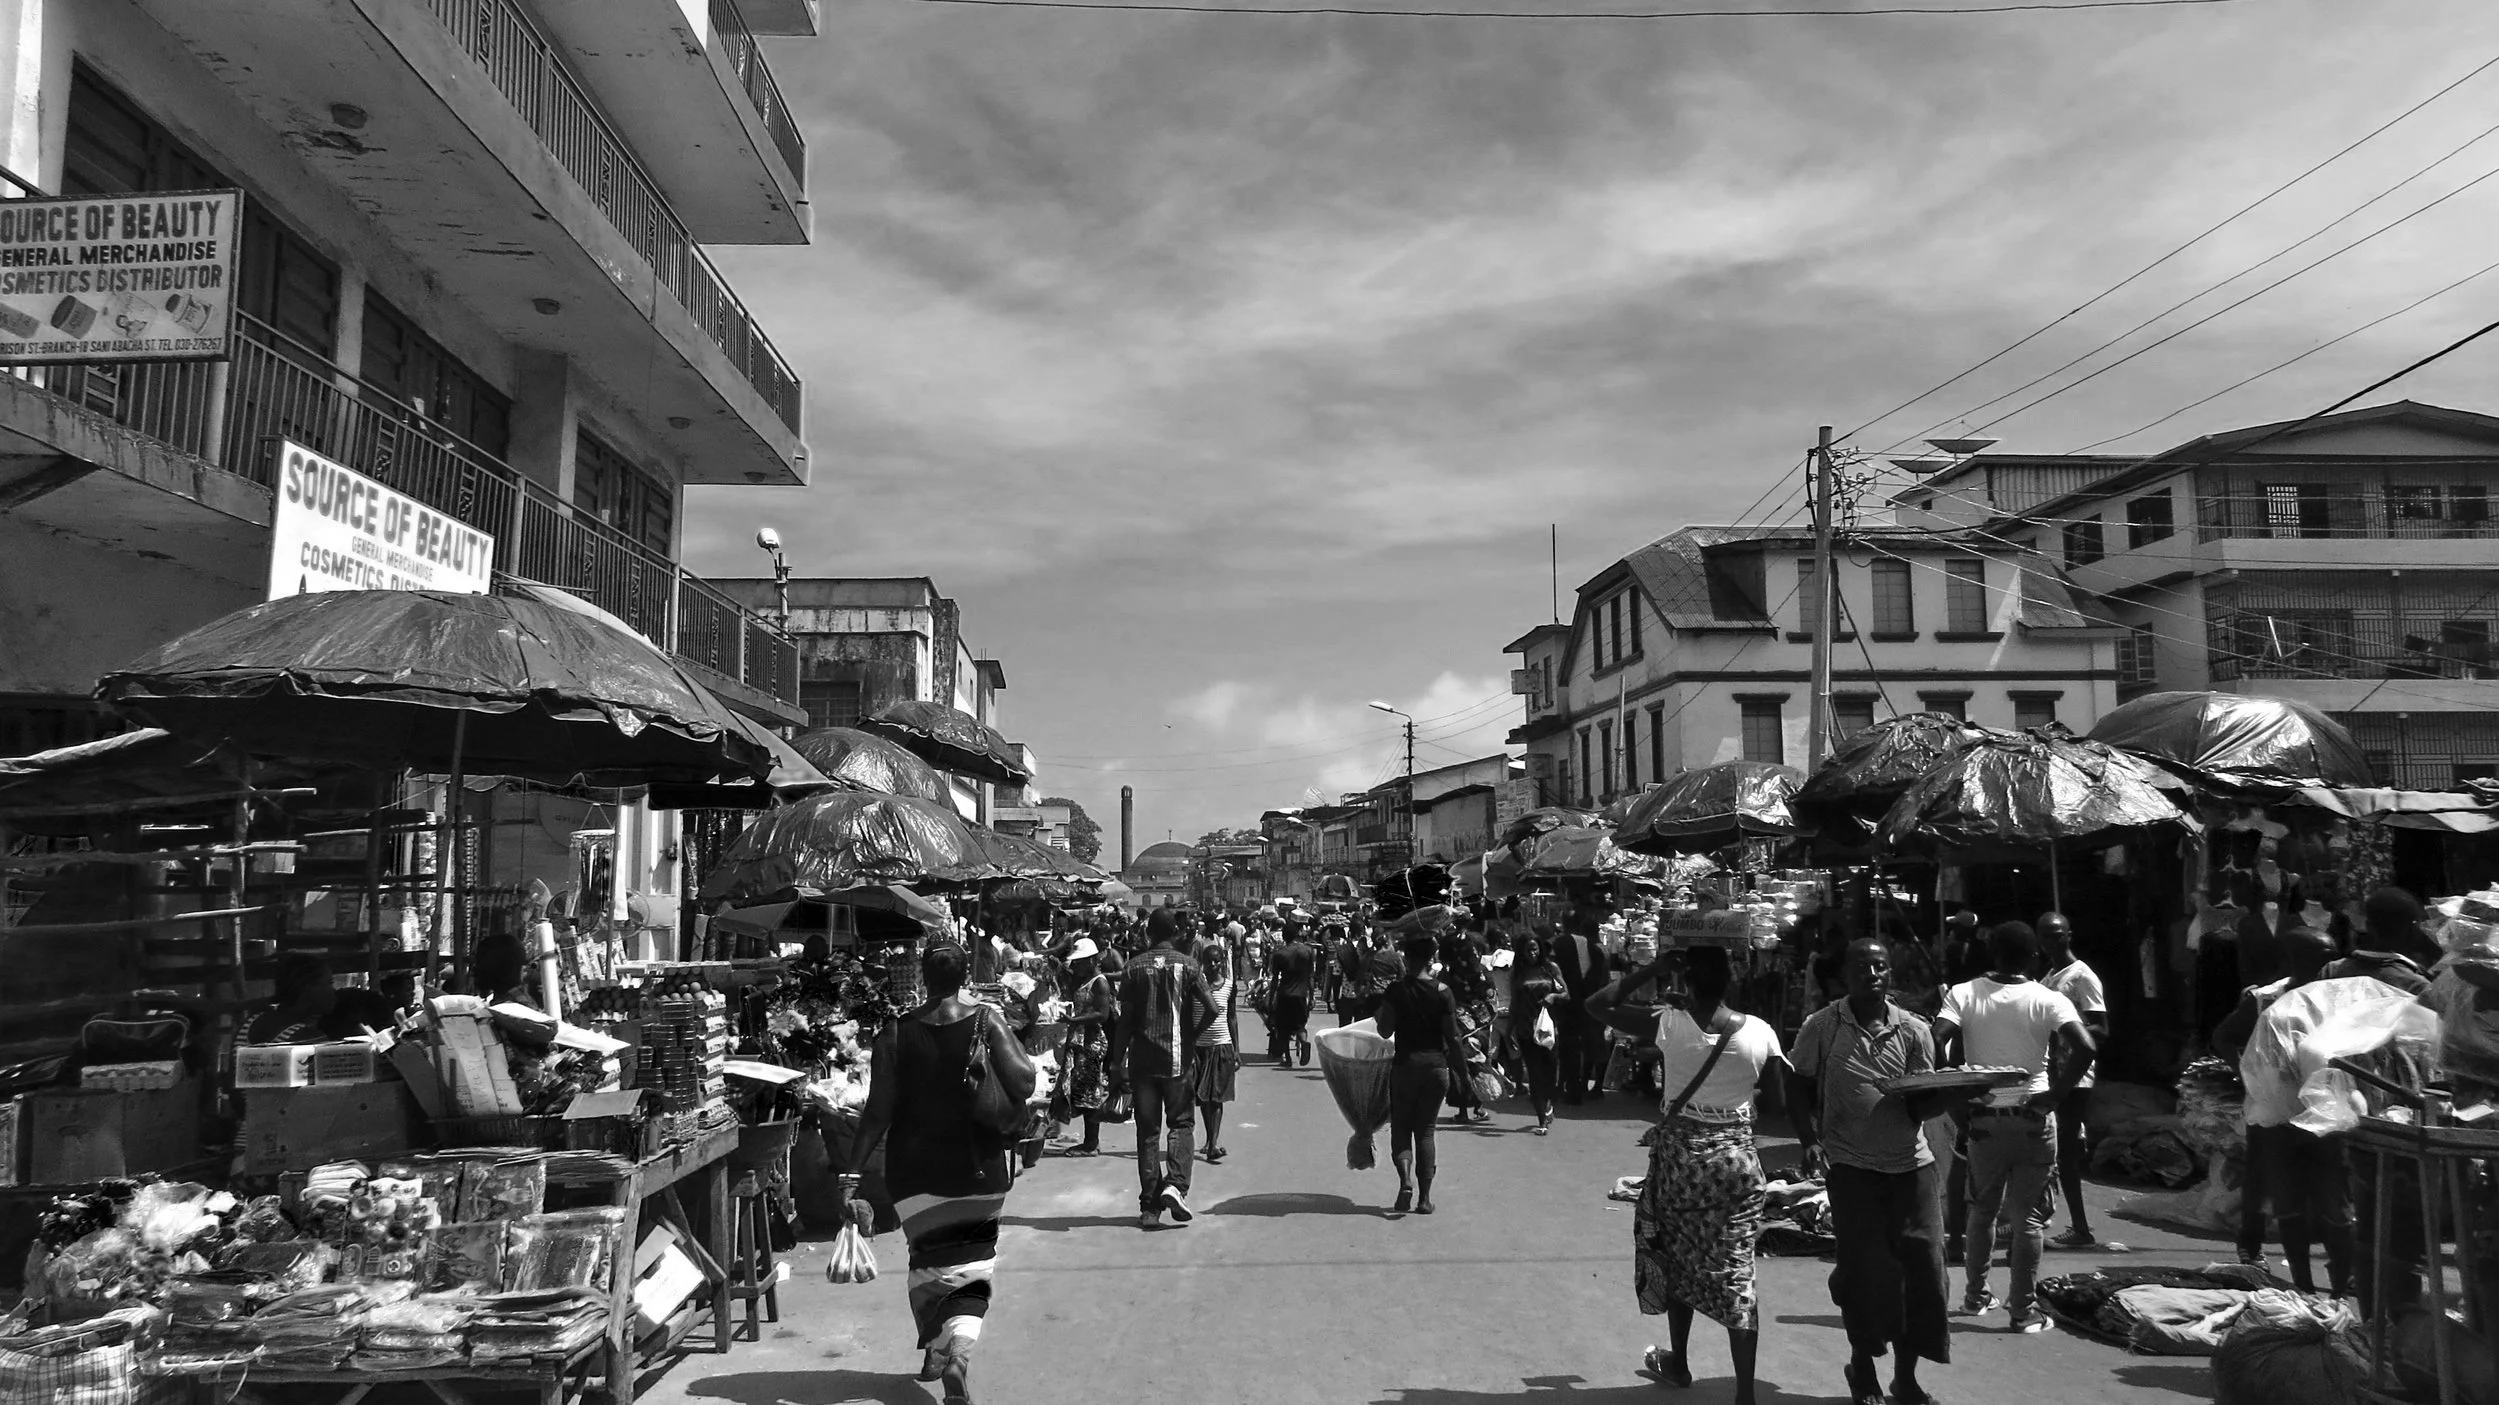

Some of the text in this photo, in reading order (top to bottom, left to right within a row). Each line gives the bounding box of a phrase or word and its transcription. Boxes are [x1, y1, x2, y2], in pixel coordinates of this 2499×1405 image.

[0, 201, 222, 244] OURCE OF BEAUTY
[0, 241, 217, 267] ENERAL MERCHANDISE
[0, 264, 223, 295] SMETICS DISTRIBUTOR
[90, 340, 111, 353] SANI
[112, 340, 143, 353] ABACHA
[286, 451, 490, 580] SOURCE OF BEAUTY
[300, 541, 384, 590] COSMETICS
[352, 536, 384, 563] GENERAL
[386, 549, 435, 583] MERCHANDISE
